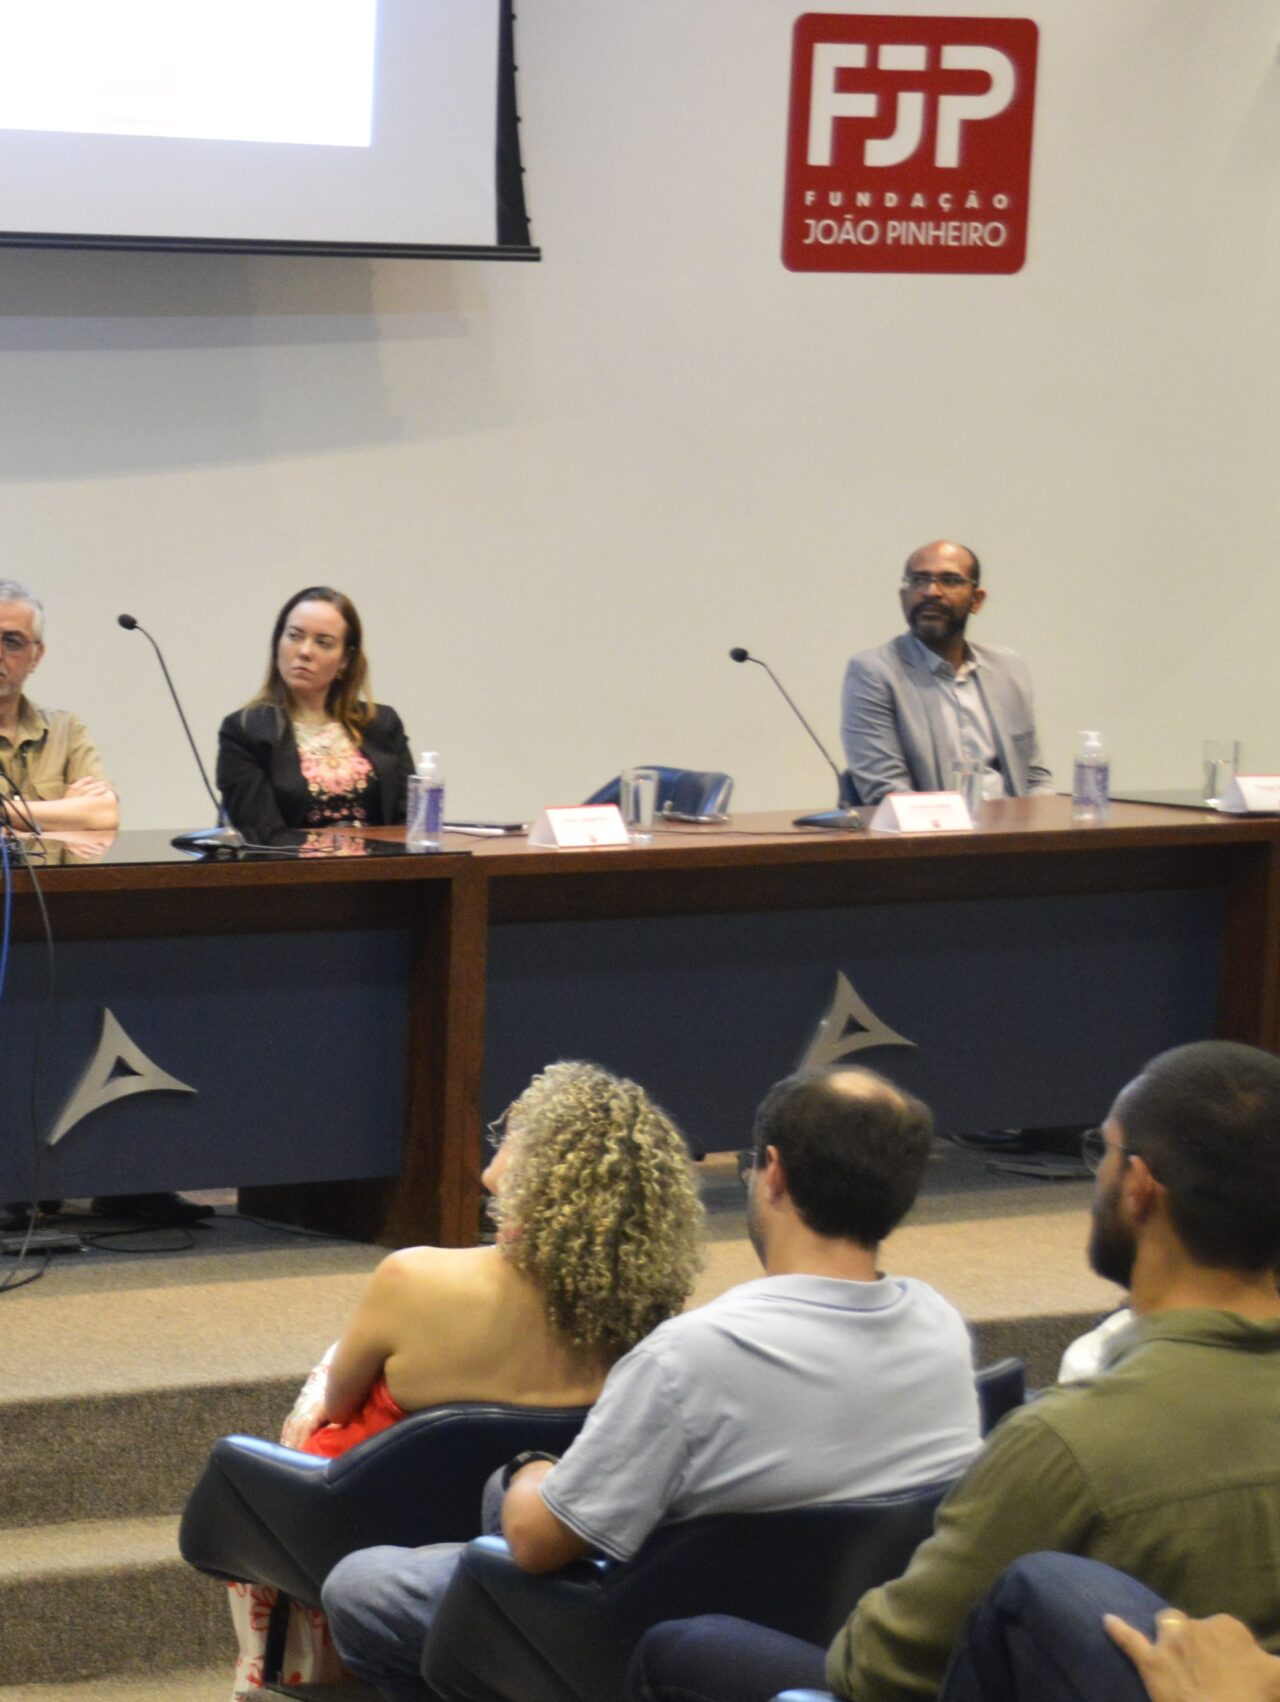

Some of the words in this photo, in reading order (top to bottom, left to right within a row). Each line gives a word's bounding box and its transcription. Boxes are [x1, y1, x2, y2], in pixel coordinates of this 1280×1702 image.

[807, 43, 1016, 168] FJP
[804, 190, 1010, 213] FUNDAÇÃO
[803, 214, 880, 245] JOÃO
[886, 220, 1008, 247] PINHEIRO
